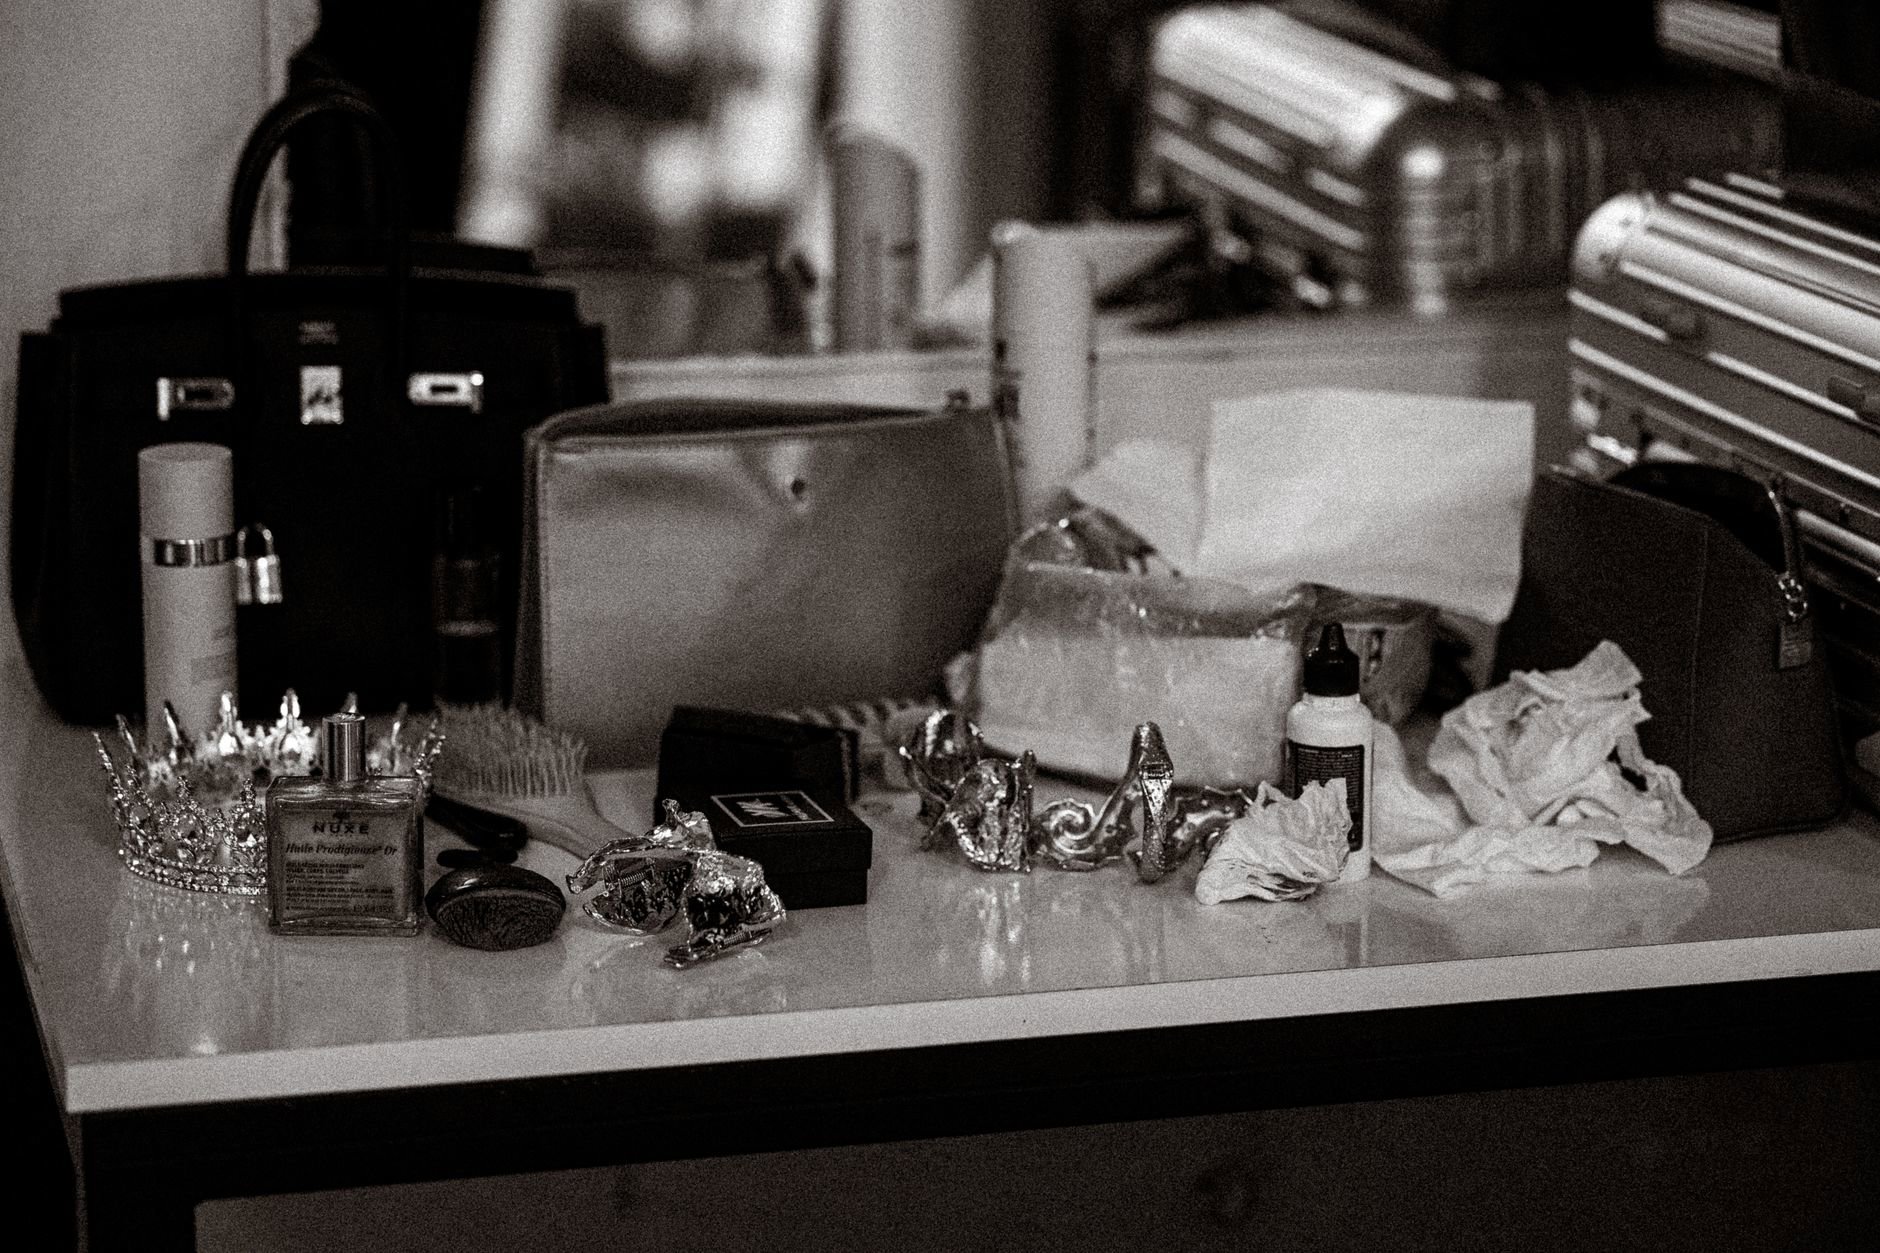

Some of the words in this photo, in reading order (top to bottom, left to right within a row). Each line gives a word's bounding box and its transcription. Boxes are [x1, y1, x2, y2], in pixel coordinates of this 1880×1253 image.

[313, 823, 369, 834] NUXE
[285, 843, 314, 854] Huile
[384, 845, 398, 856] Or
